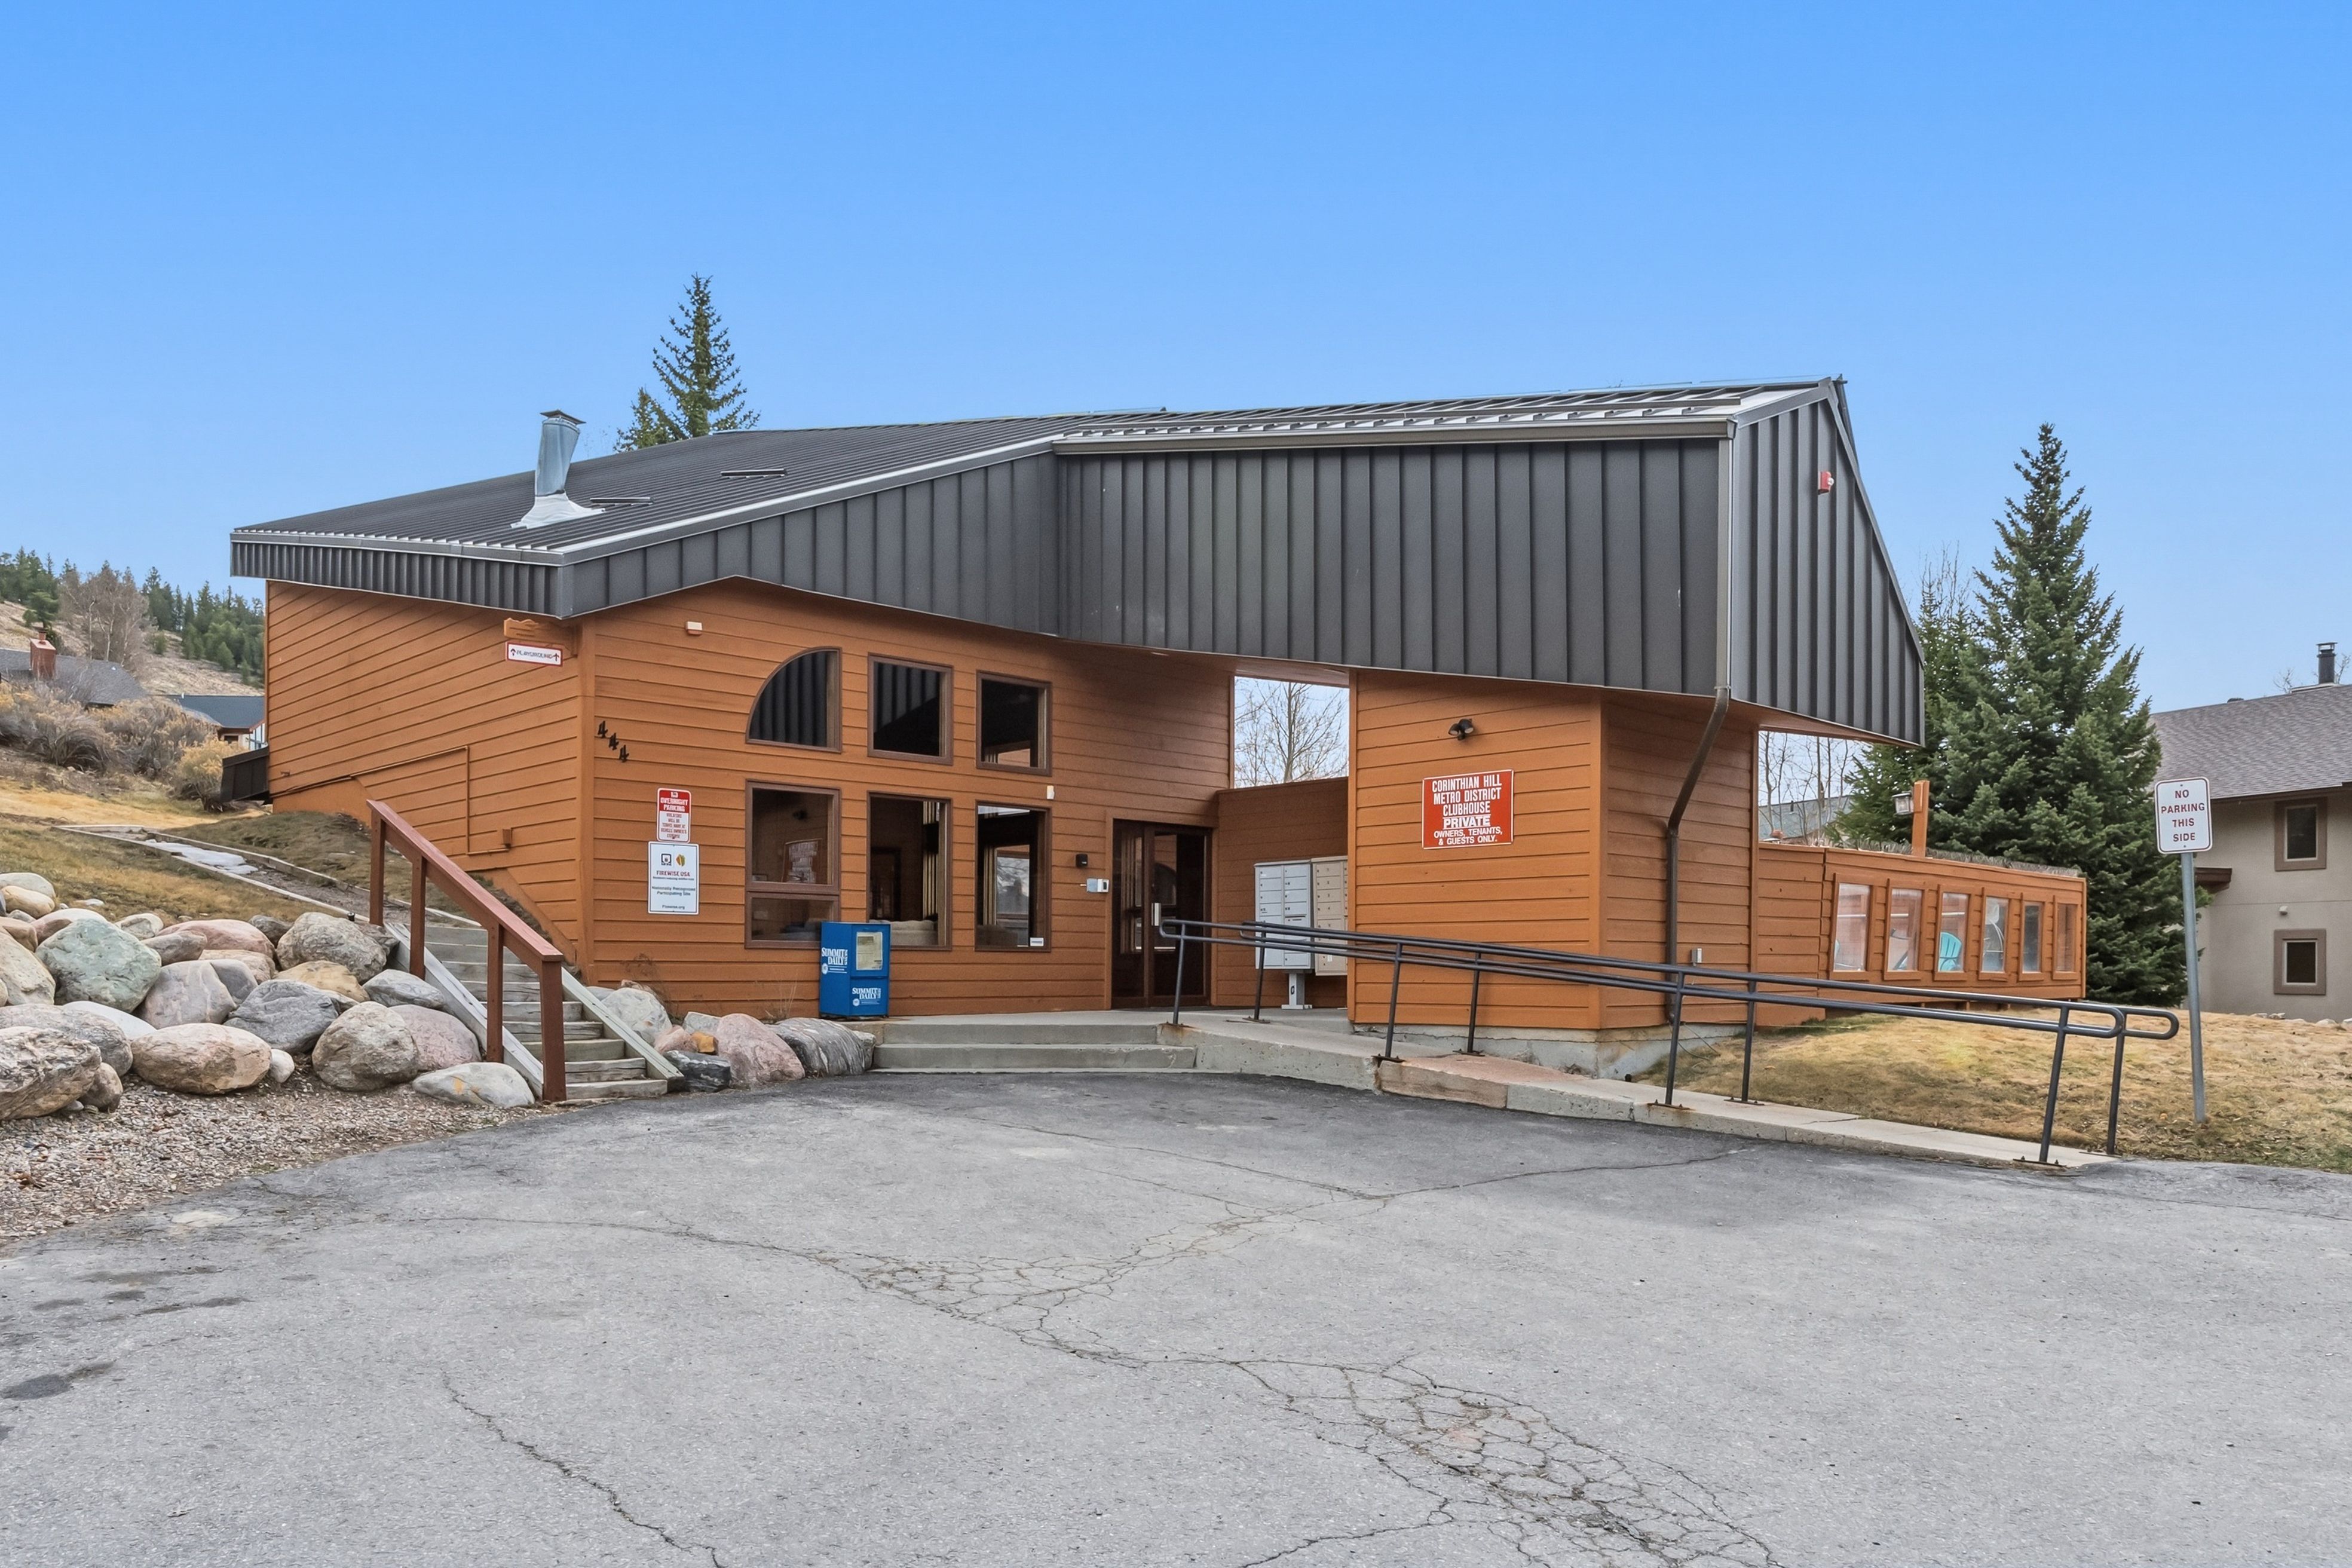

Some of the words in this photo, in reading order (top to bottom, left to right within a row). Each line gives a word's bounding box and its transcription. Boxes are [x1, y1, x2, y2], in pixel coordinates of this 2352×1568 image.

[598, 721, 629, 763] 444
[1432, 776, 1480, 792] CORINTHIAN
[1483, 774, 1502, 788] HILL
[1434, 791, 1461, 805] METRO
[1464, 787, 1502, 802] DISTRICT
[2175, 789, 2189, 798] NO
[660, 797, 688, 806] OVERNIGHT
[1443, 801, 1490, 816] CLUBHOUSE
[2161, 803, 2205, 814] PARKING
[1443, 816, 1490, 829] PRIVATE
[2172, 818, 2194, 828] THIS
[1434, 829, 1465, 838] OWNERS,
[1468, 826, 1502, 836] TENANTS,
[2173, 832, 2195, 842] SIDE
[1447, 837, 1475, 845] GUESTS
[1477, 835, 1497, 843] ONLY.
[822, 947, 845, 957] SUMMIT
[828, 956, 844, 965] DAILY
